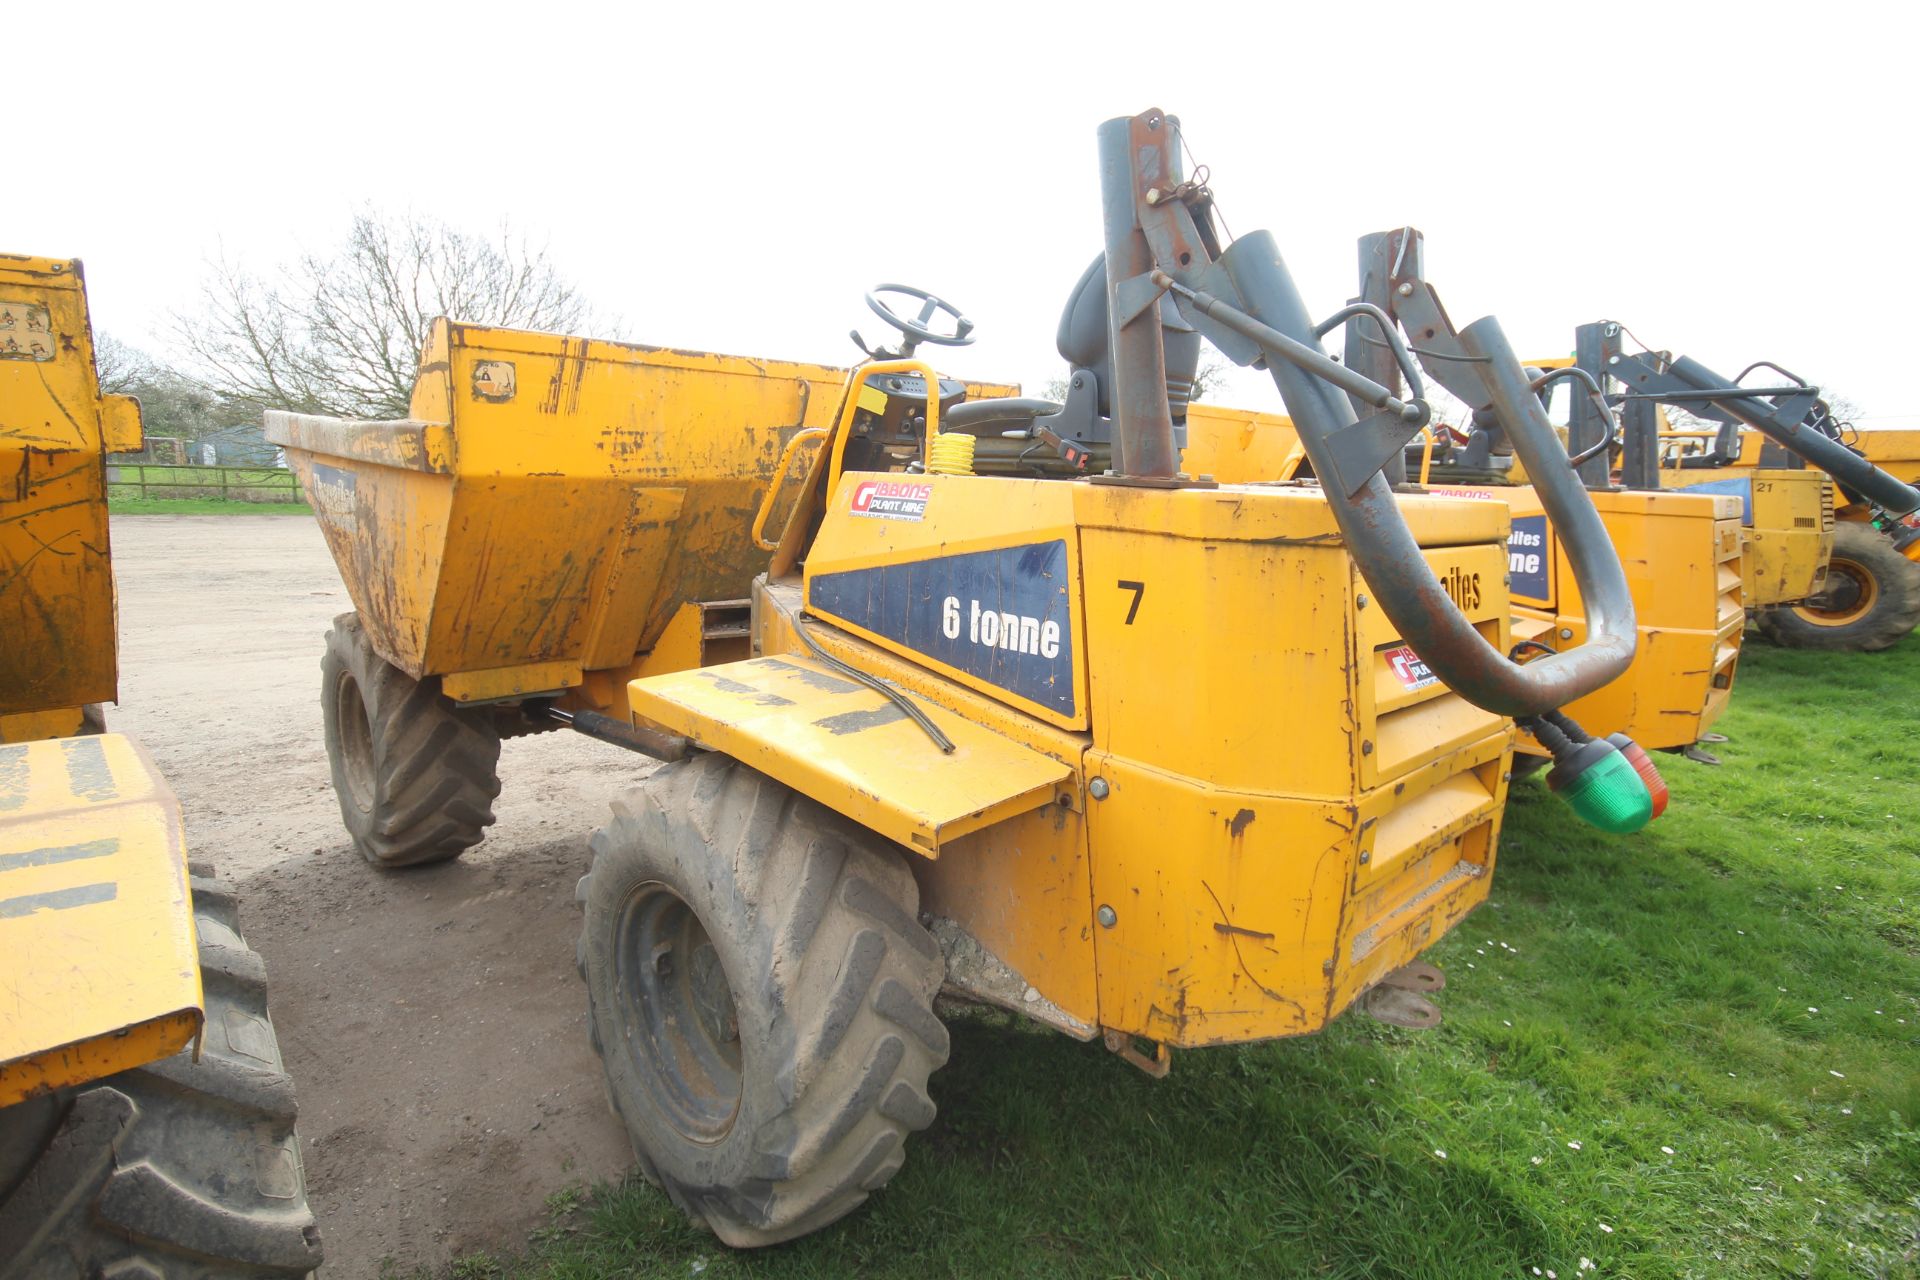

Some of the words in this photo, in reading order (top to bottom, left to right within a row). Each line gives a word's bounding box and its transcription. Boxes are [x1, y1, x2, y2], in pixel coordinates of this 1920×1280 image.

[852, 481, 934, 512] GIBBONS
[1756, 482, 1773, 493] 21
[870, 499, 902, 511] PLANT
[901, 502, 925, 513] HIRE
[1507, 552, 1540, 574] ne
[1117, 579, 1145, 625] 7
[942, 595, 961, 640] 6
[969, 599, 1060, 659] tonne
